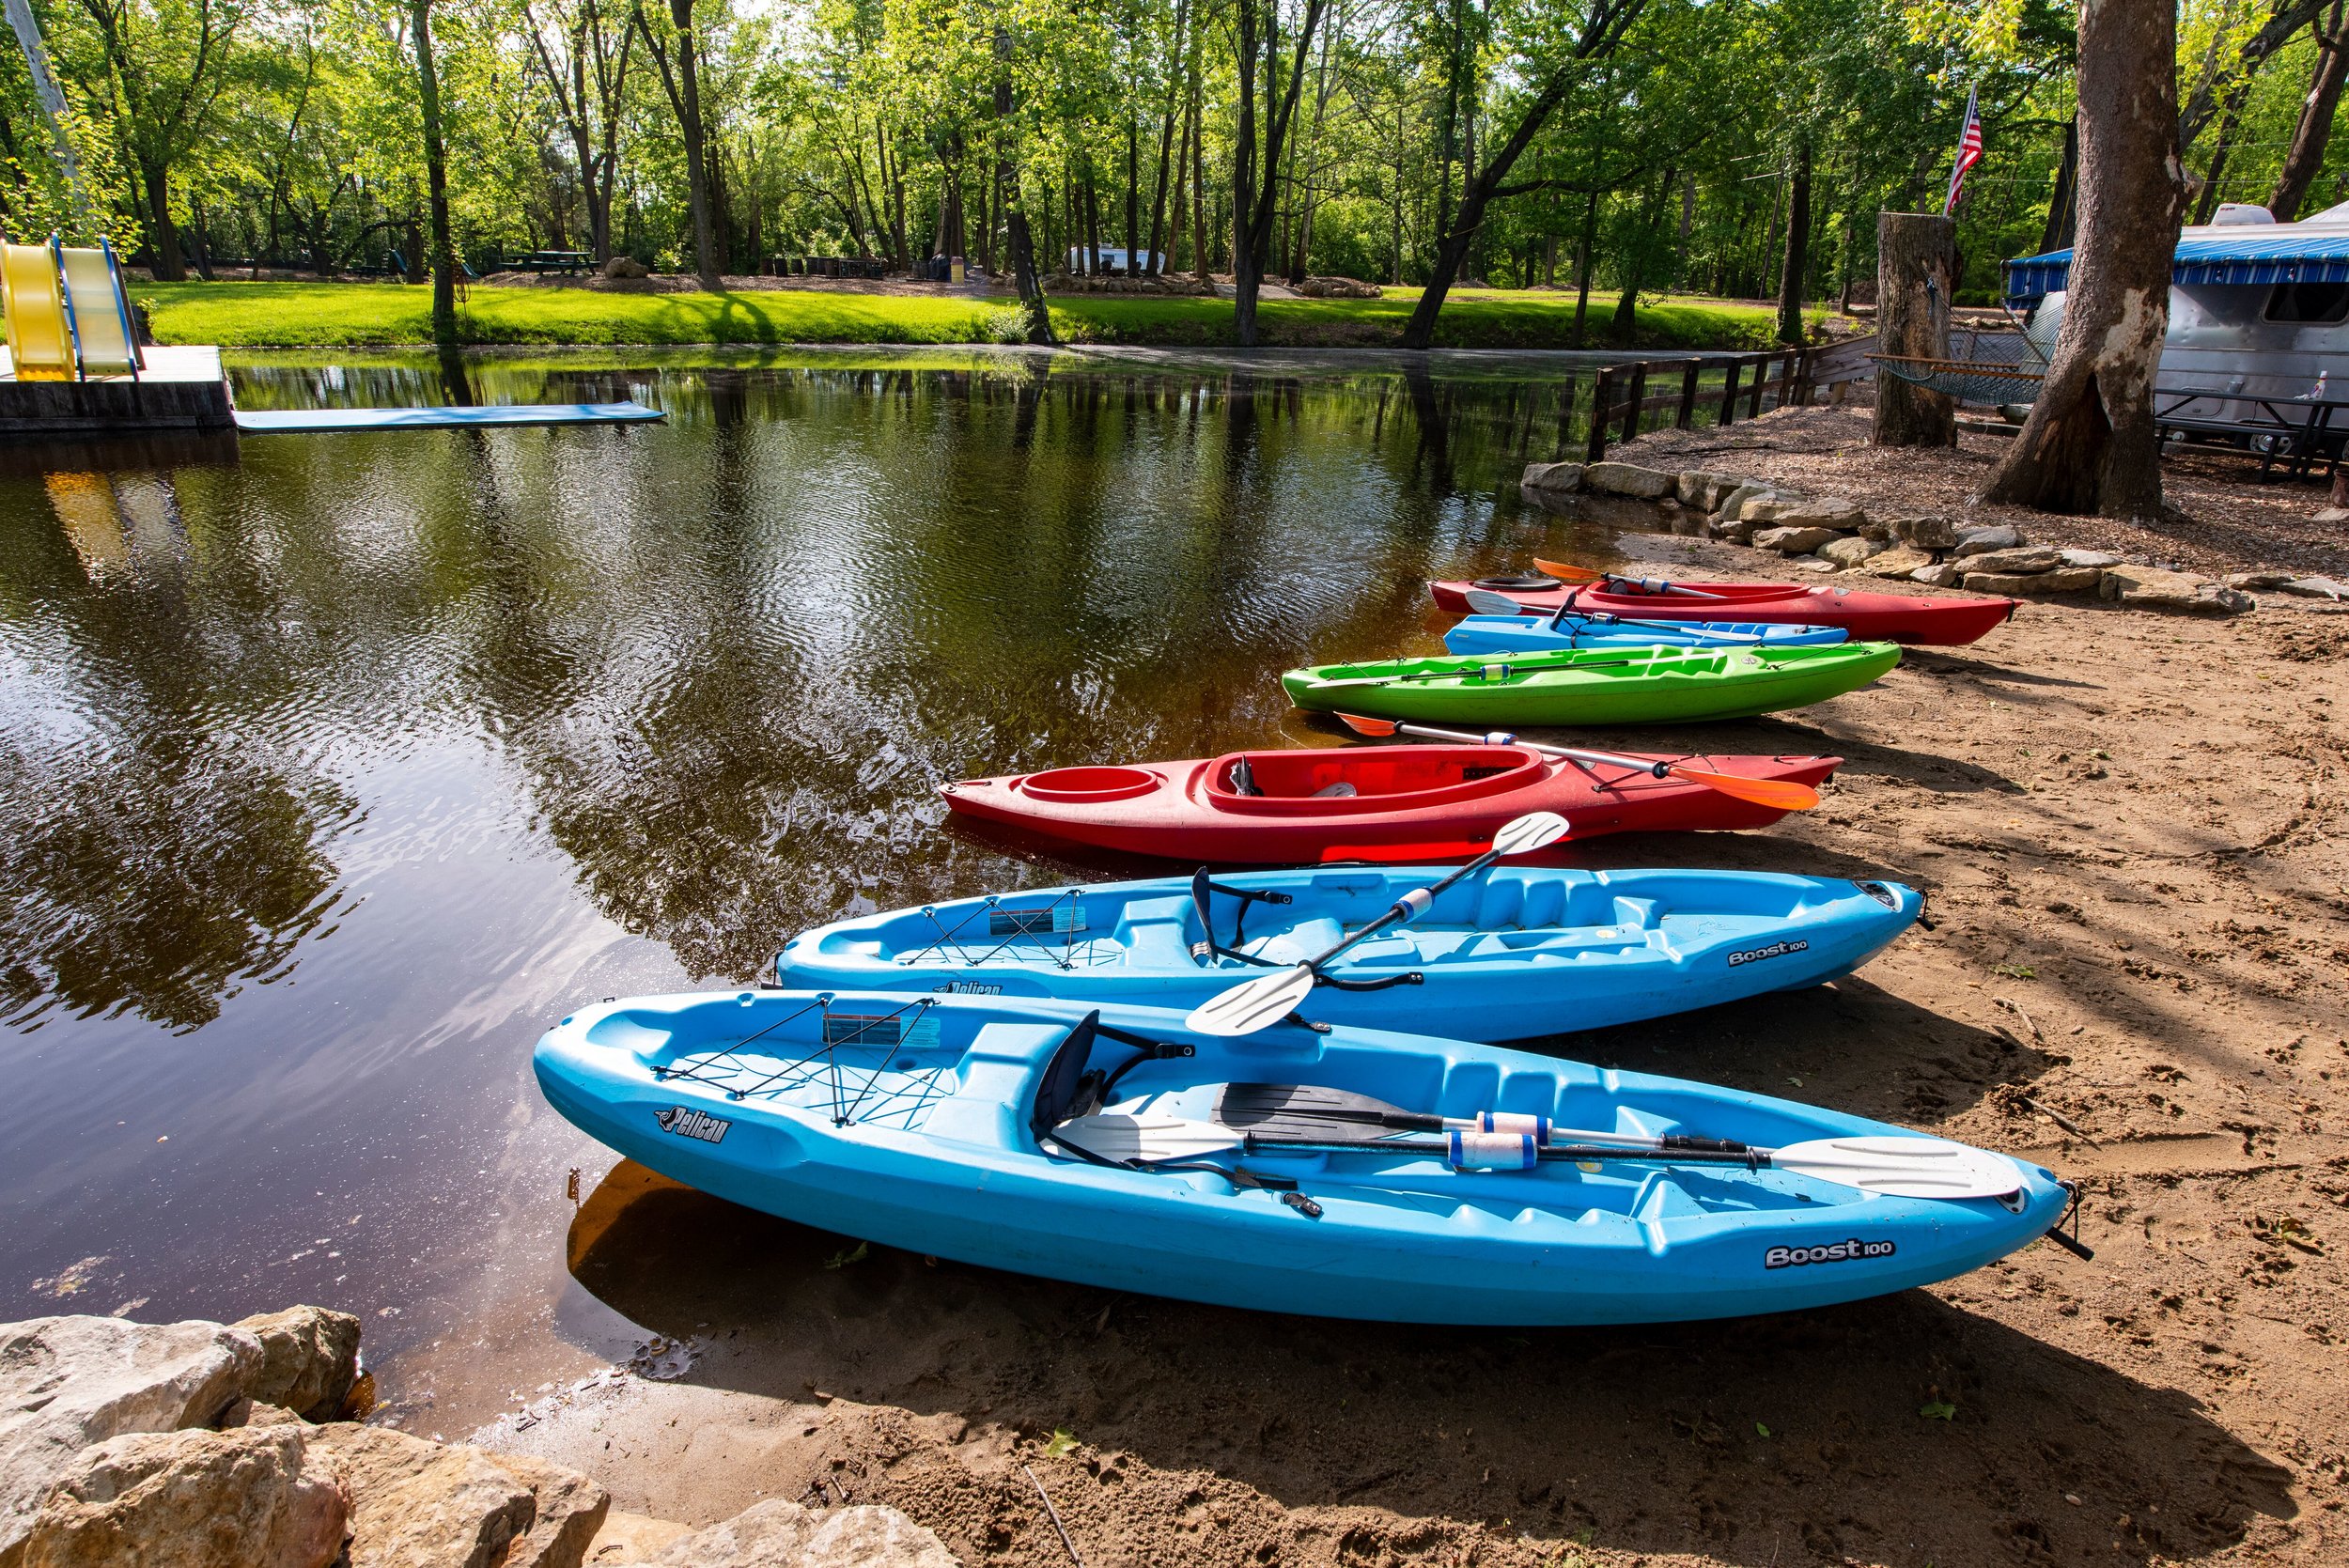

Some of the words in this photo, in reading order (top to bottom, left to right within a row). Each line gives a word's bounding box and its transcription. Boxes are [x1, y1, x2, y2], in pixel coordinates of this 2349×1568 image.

[1728, 942, 1787, 966] Boost
[1789, 940, 1808, 952] 100
[667, 1106, 729, 1142] Pelican
[1766, 1240, 1860, 1266] Boost
[1864, 1242, 1892, 1255] 100
